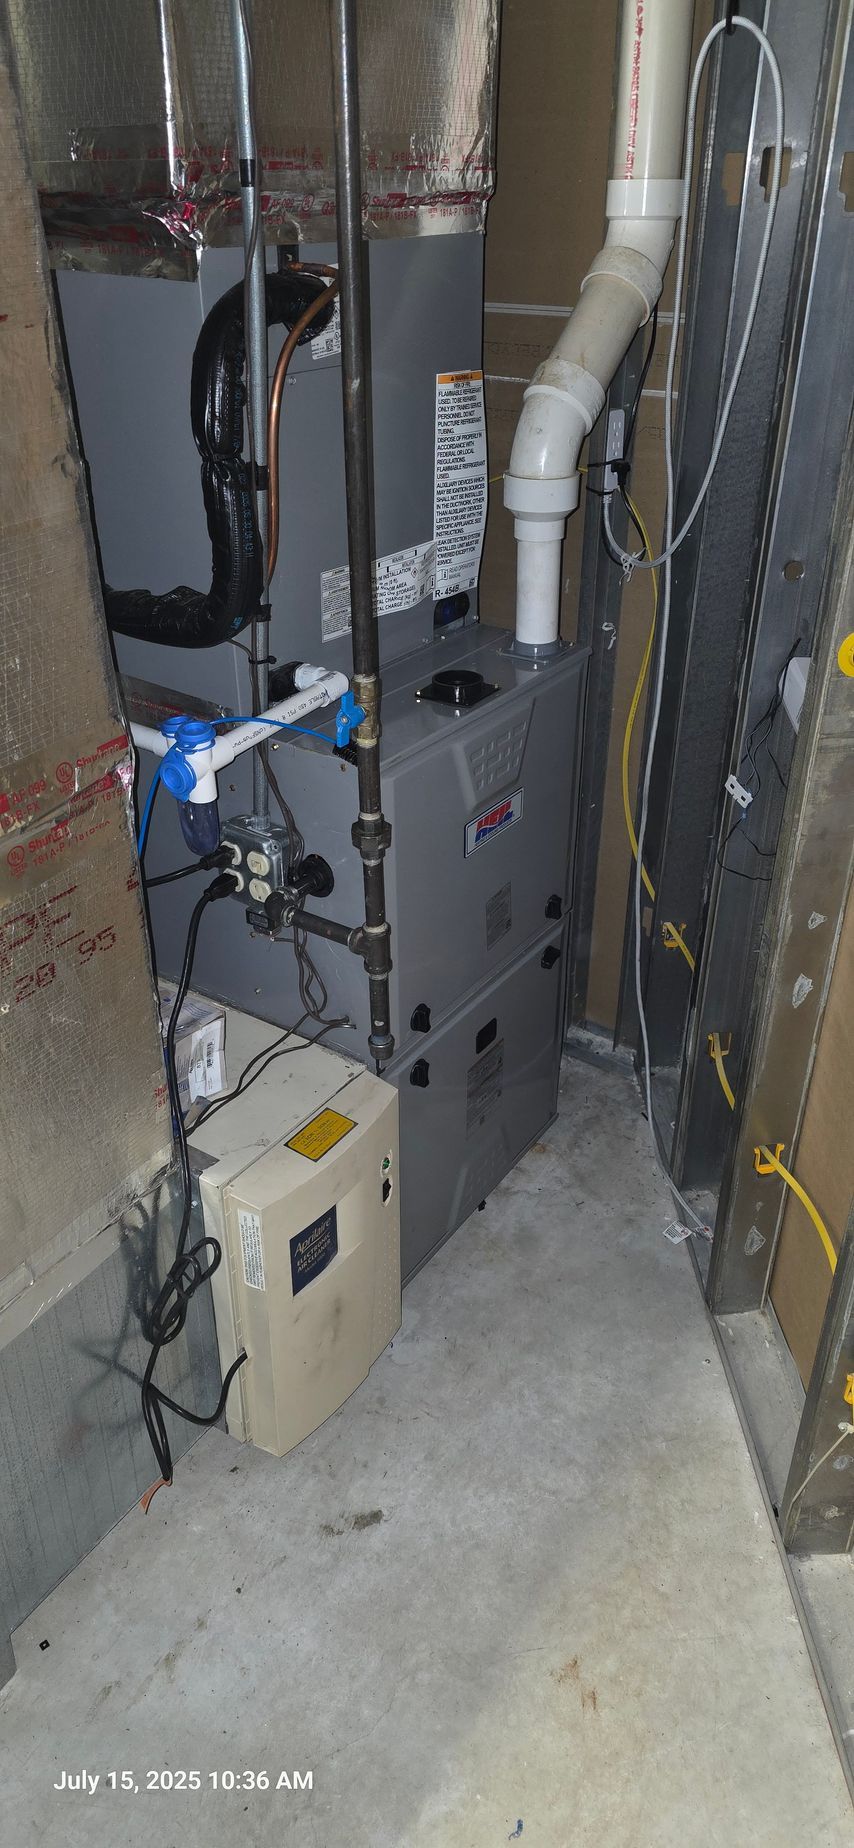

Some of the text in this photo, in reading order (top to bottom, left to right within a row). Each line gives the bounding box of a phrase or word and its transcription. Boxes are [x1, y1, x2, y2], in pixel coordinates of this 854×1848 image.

[437, 442, 466, 450] ACCORDANCE
[437, 464, 462, 472] FLAMMABLE
[445, 584, 460, 595] 454B
[297, 1231, 331, 1267] ELECTRONIC
[308, 1238, 331, 1264] CLEANER
